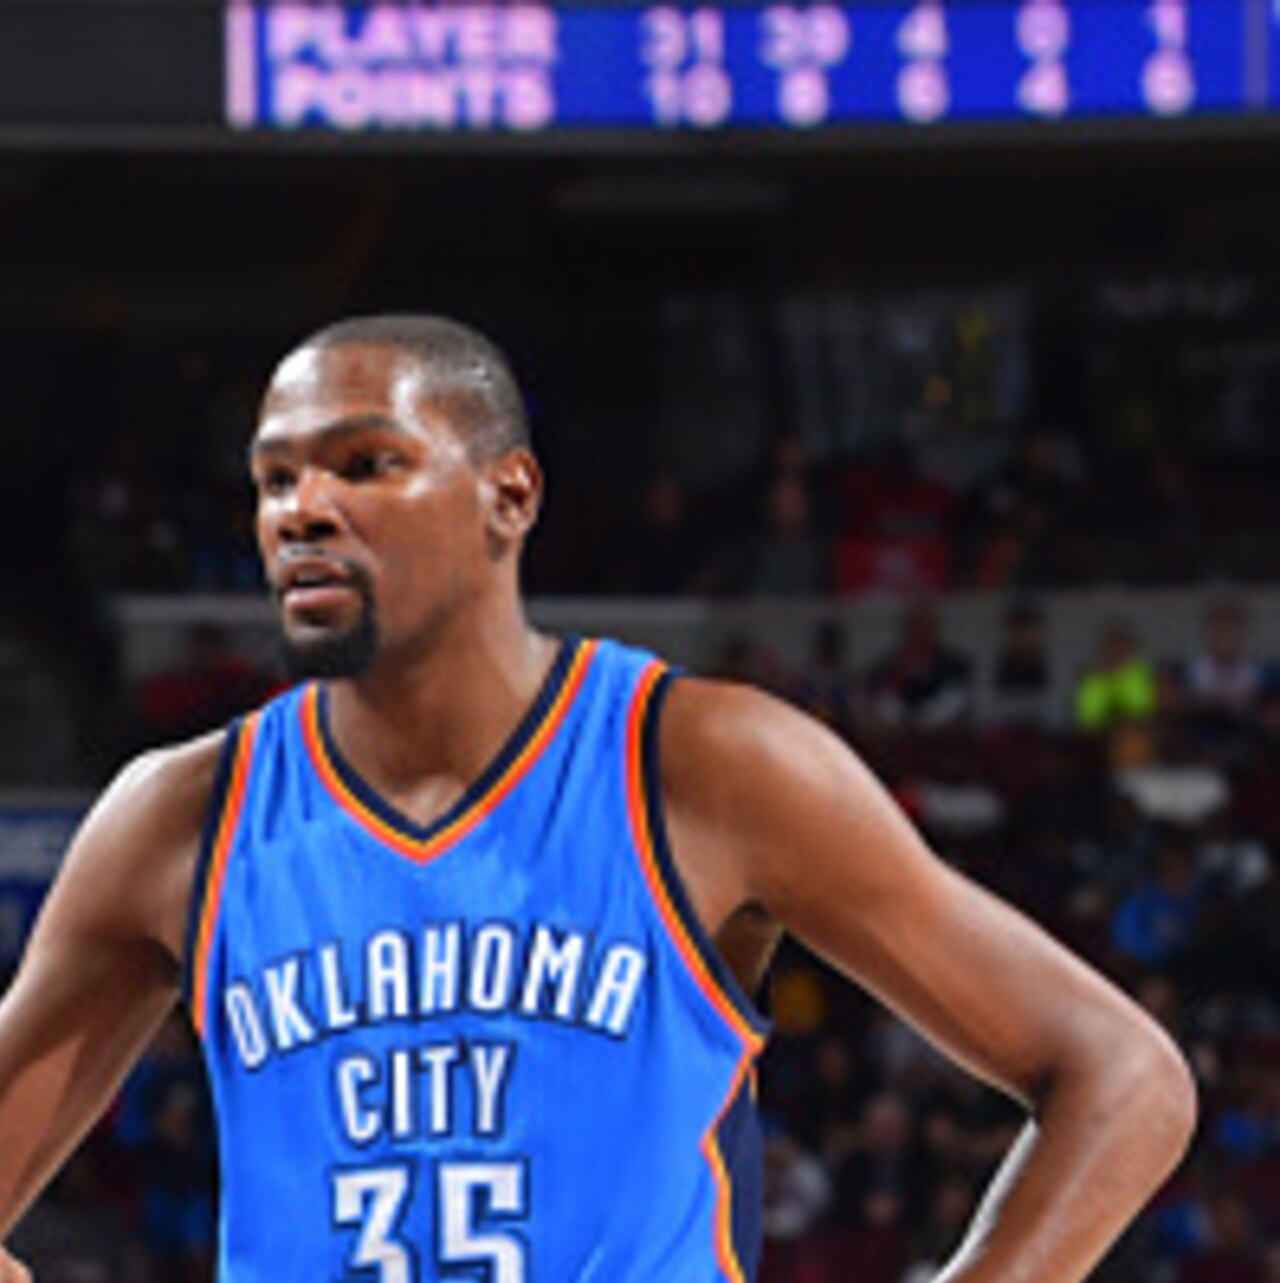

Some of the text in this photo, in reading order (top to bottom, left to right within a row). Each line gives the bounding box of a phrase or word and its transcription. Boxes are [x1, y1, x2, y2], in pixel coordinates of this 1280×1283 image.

[266, 3, 557, 65] PLAYER
[272, 66, 553, 130] POINTS
[223, 921, 648, 1070] OKLAHOMA
[336, 1042, 512, 1146] CITY
